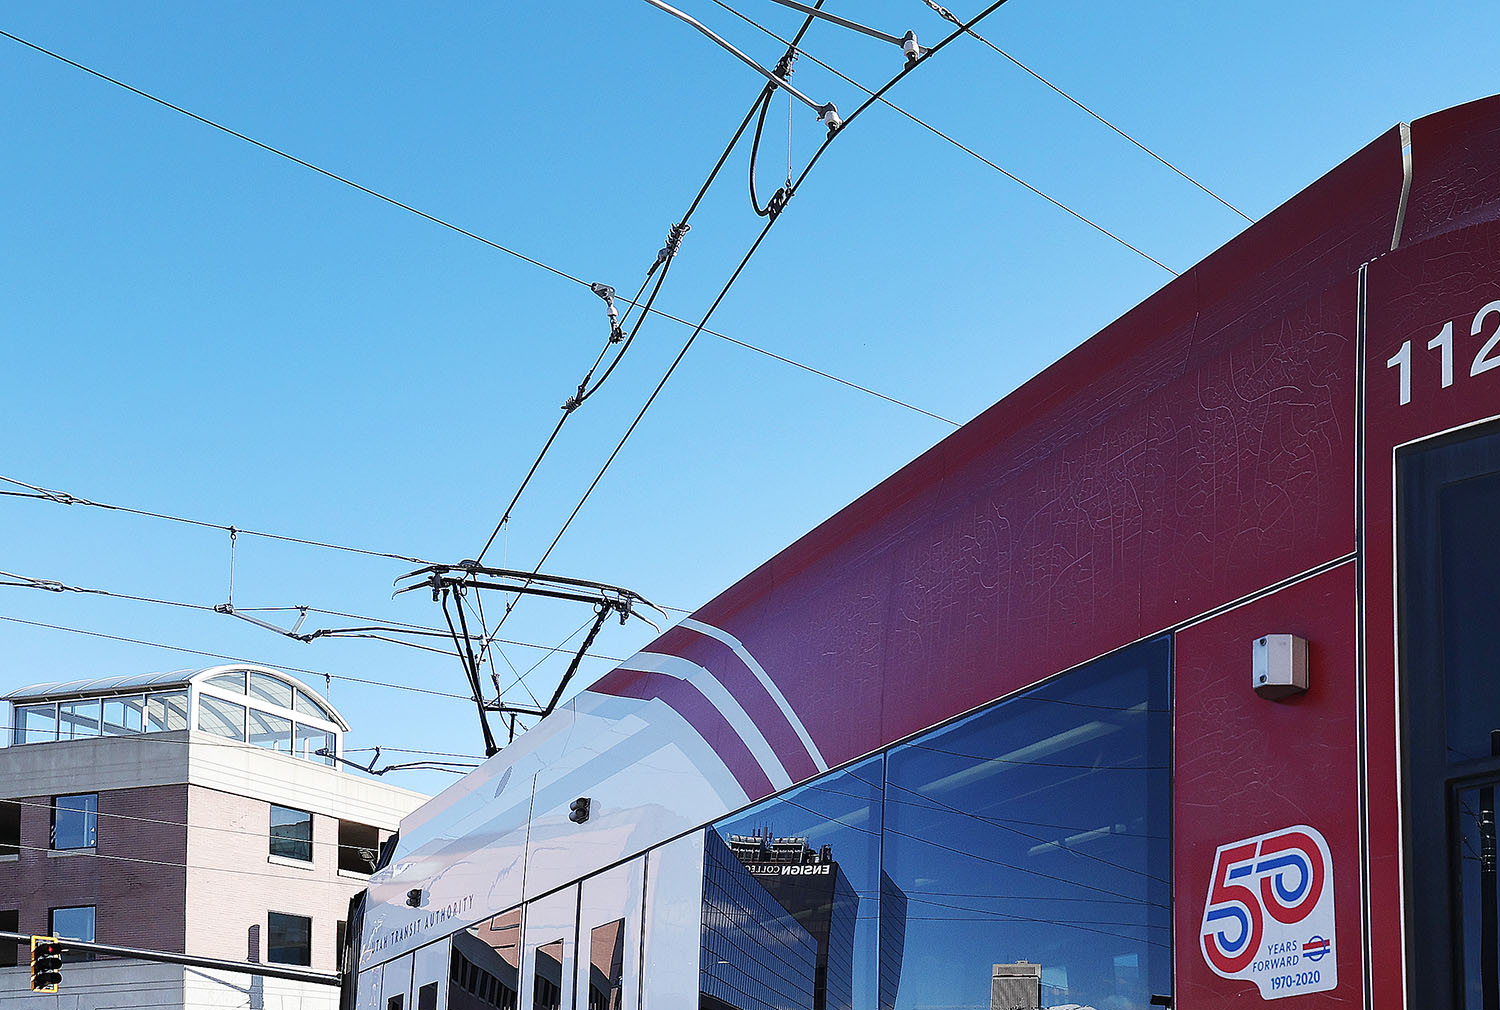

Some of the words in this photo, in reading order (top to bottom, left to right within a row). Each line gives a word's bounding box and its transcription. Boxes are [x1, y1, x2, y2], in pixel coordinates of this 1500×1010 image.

[1203, 832, 1325, 973] 50
[391, 919, 422, 945] TRANSIT
[424, 894, 474, 929] AUTHORITY
[1268, 941, 1297, 955] YEARS
[1252, 955, 1299, 972] FORWARD
[1271, 971, 1320, 990] 1970-2020
